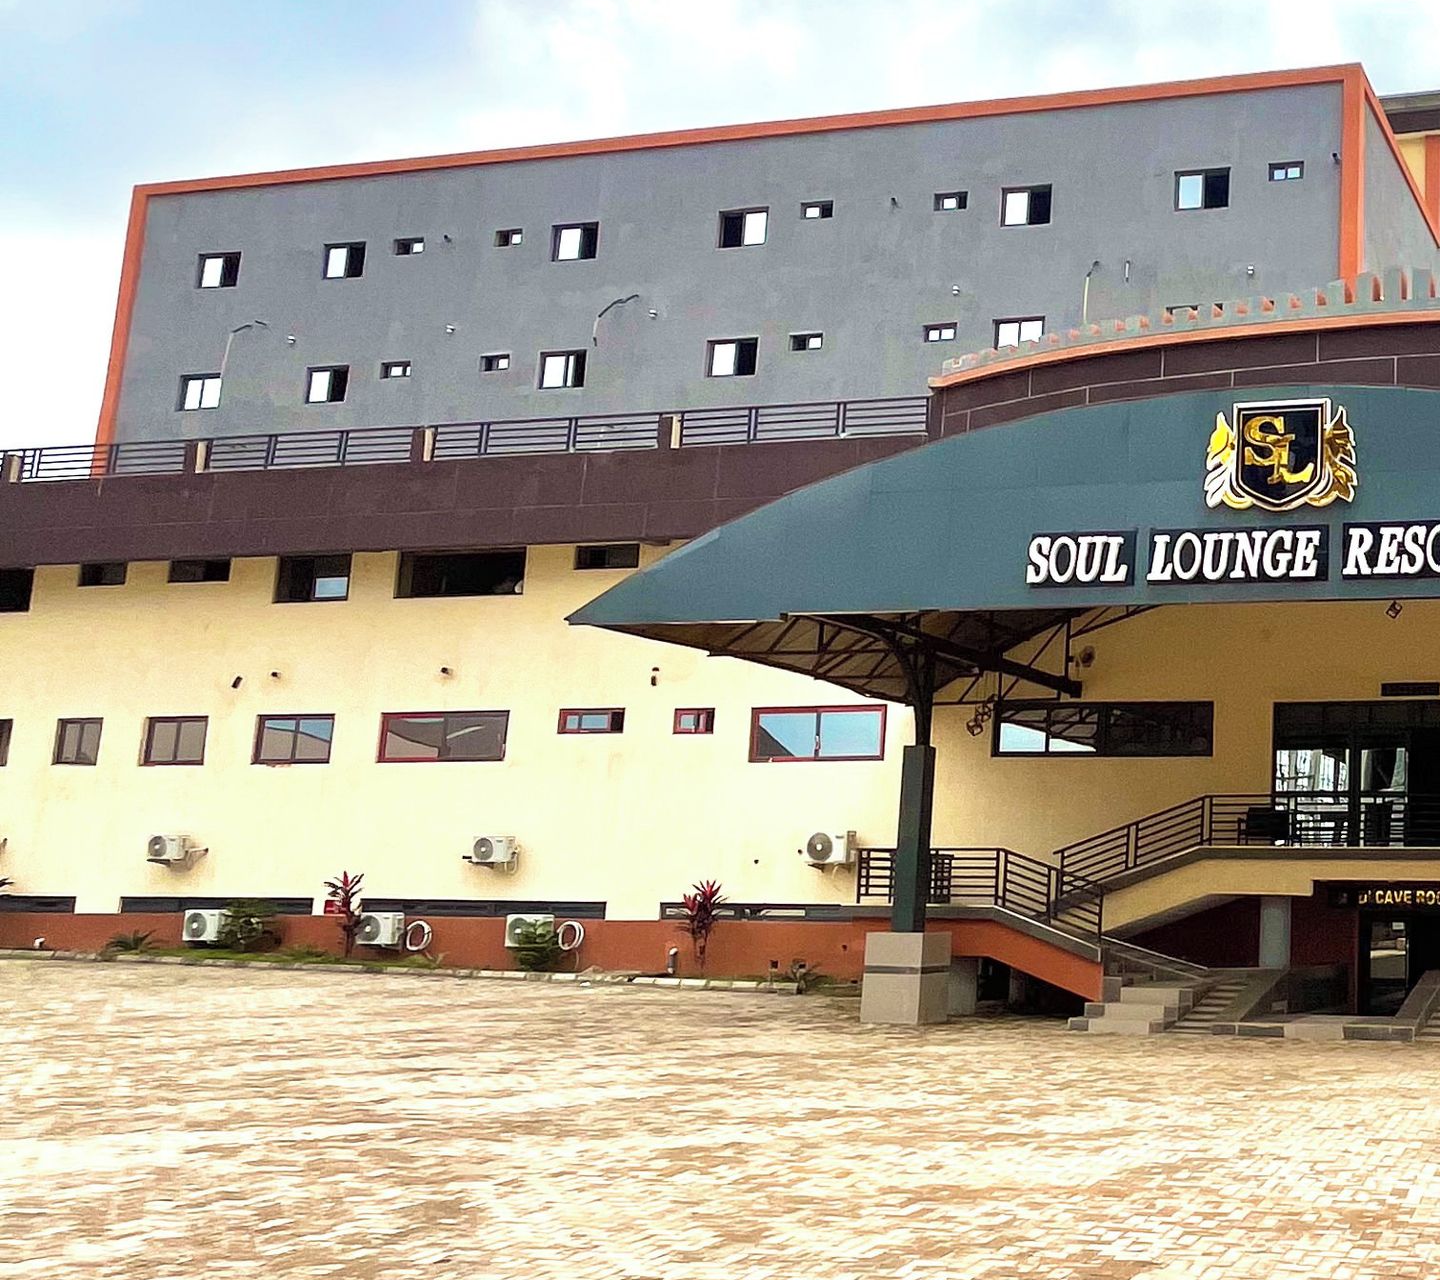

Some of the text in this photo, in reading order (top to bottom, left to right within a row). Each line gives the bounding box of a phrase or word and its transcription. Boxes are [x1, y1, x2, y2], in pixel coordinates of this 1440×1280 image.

[1026, 535, 1128, 584] SOUL
[1146, 529, 1322, 581] LOUNGE
[1375, 890, 1412, 905] CAVE
